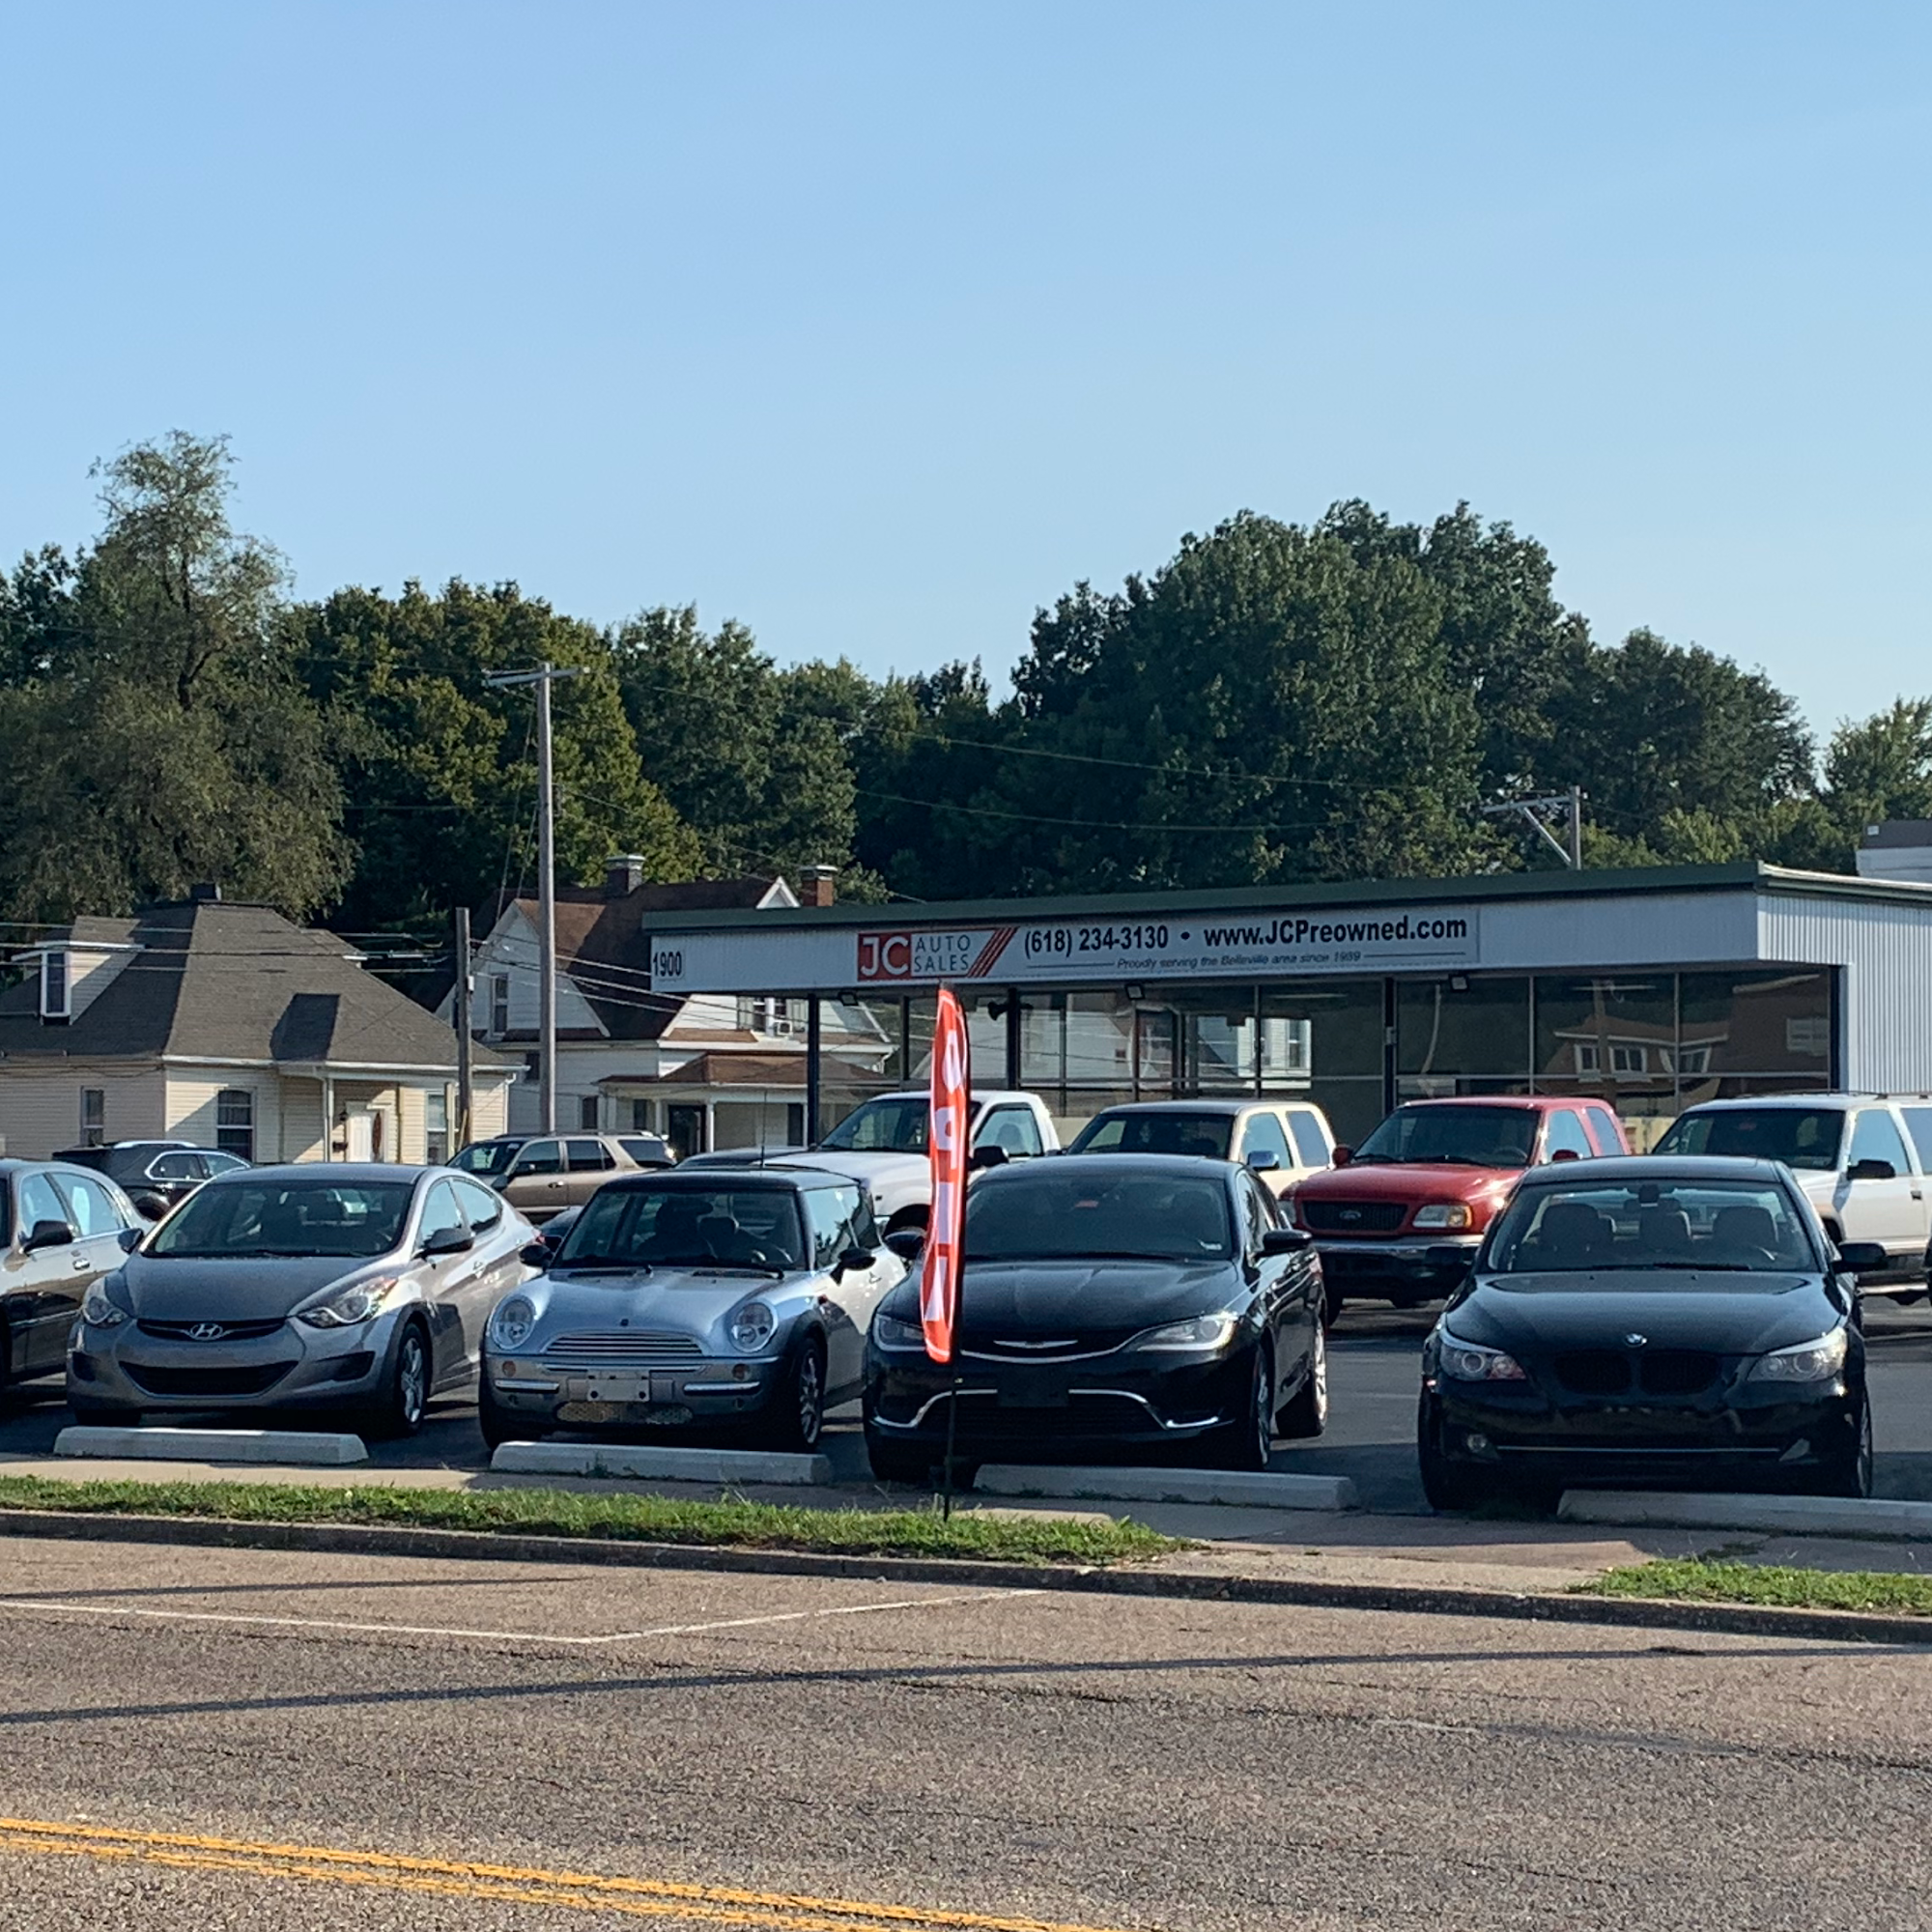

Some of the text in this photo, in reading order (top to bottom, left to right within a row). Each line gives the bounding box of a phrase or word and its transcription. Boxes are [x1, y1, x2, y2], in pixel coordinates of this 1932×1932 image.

[915, 934, 971, 952] AUTO
[1025, 915, 1467, 959] (618) 234-3130 www.JCPreowned.com
[653, 951, 682, 977] 1900
[860, 935, 909, 977] JC
[914, 953, 970, 973] SALES
[1117, 957, 1157, 970] Proudly
[1159, 957, 1199, 970] serving
[1201, 955, 1219, 966] the
[1271, 954, 1297, 964] area
[1299, 953, 1329, 963] since
